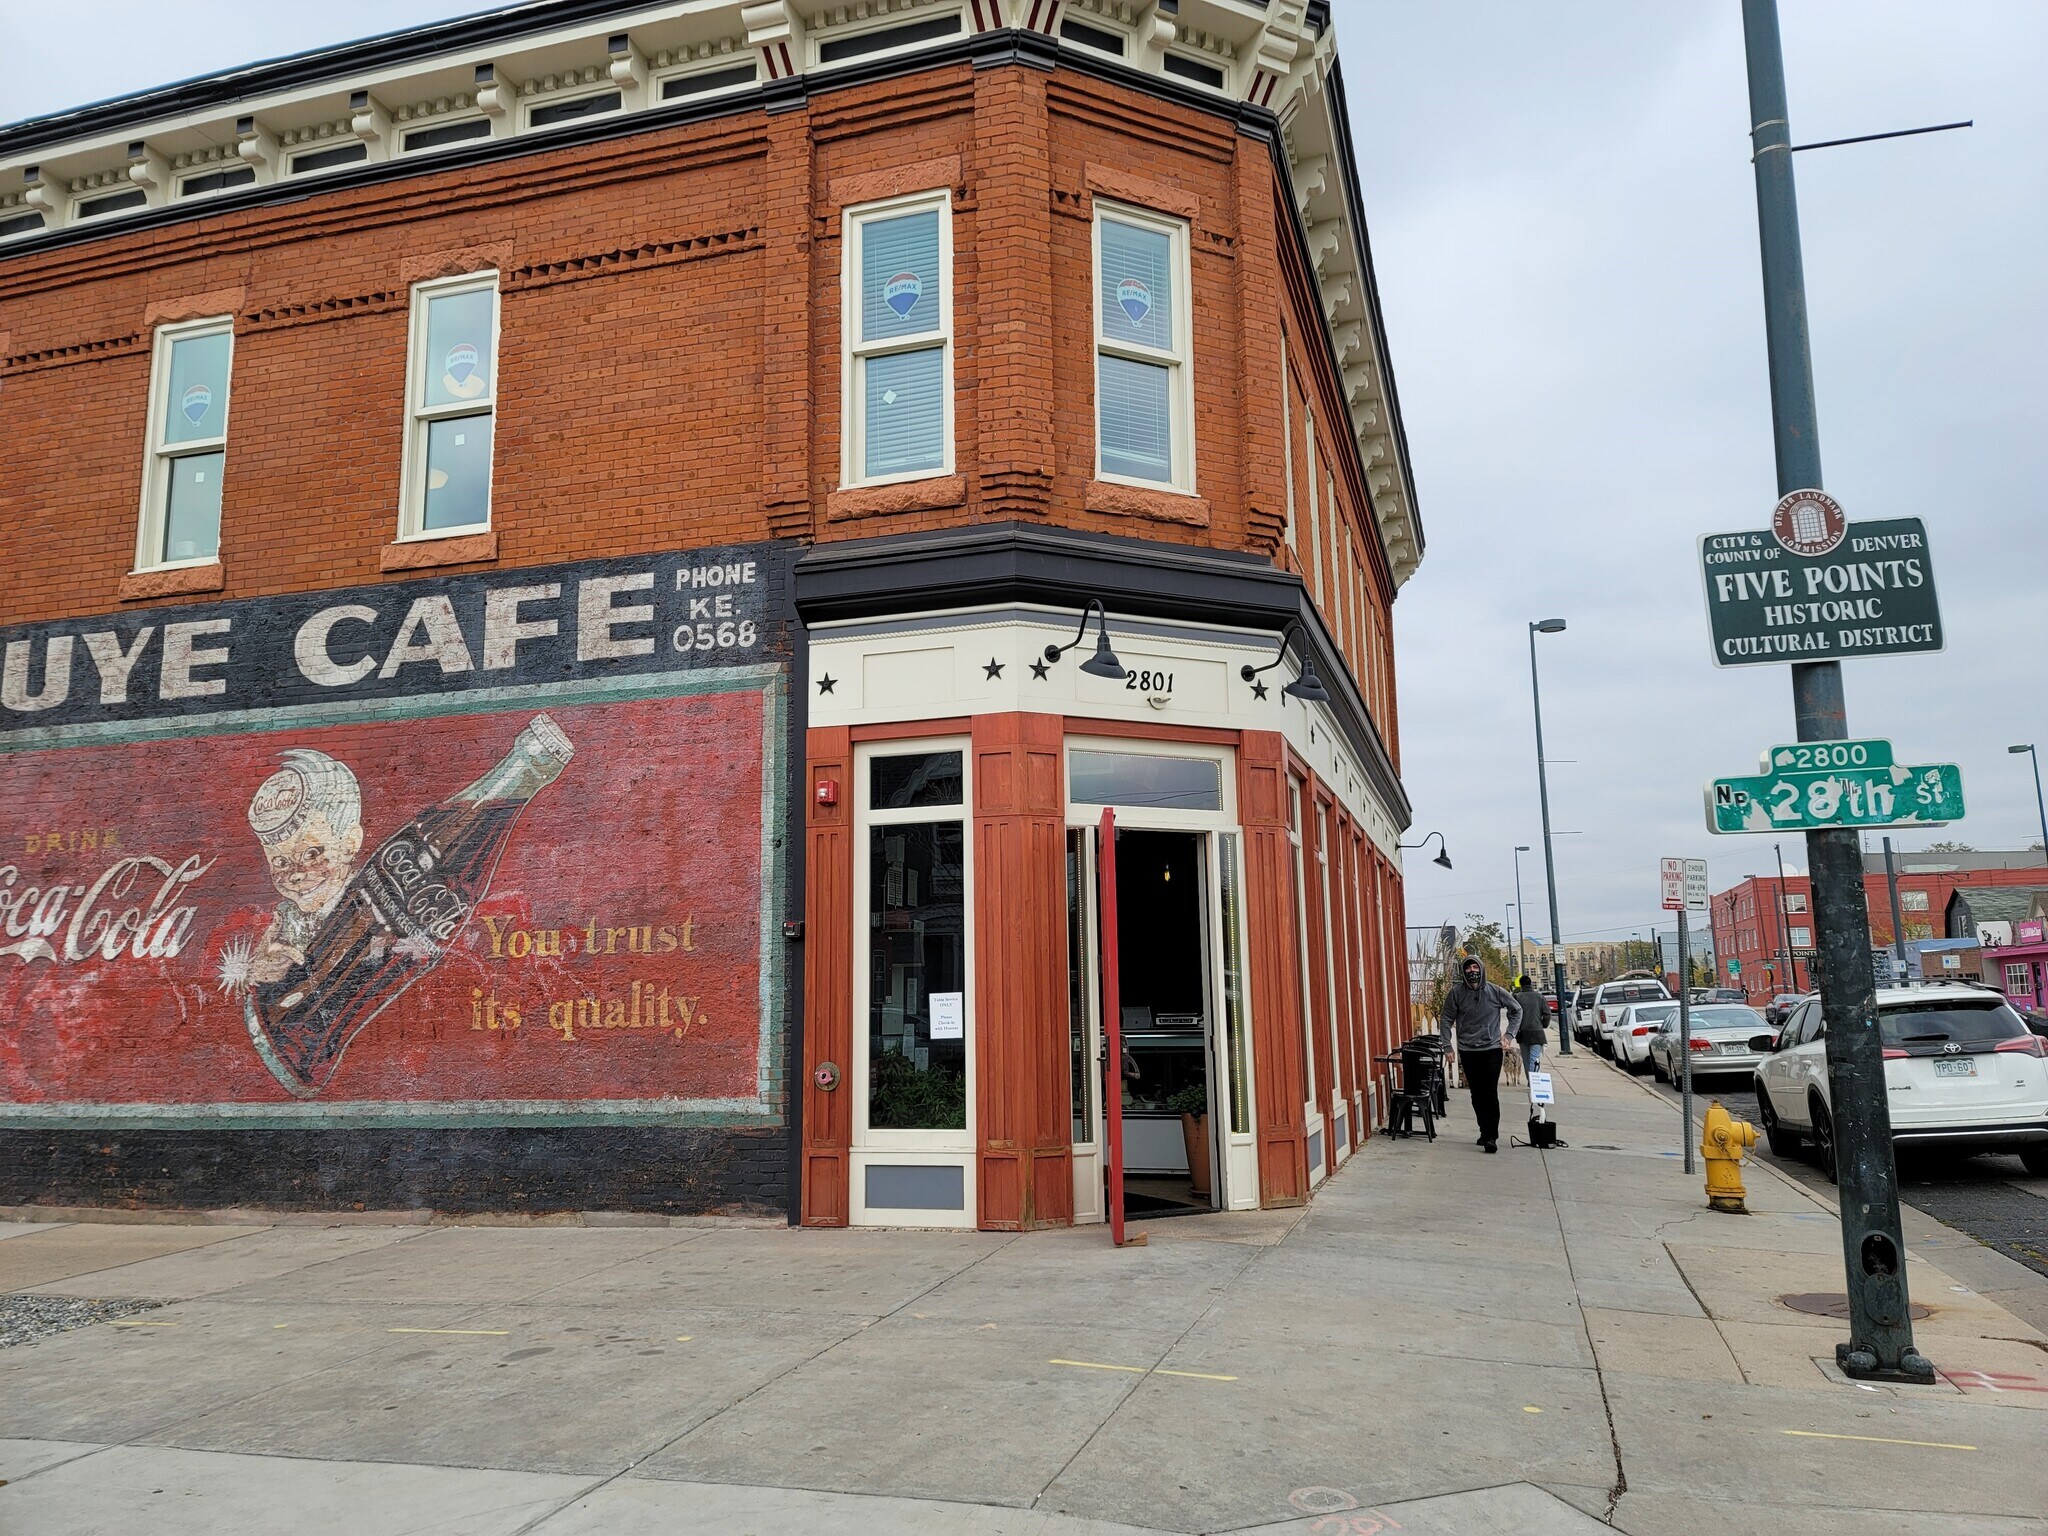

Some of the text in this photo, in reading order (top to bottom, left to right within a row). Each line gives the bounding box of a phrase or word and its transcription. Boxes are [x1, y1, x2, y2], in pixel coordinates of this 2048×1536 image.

[890, 284, 917, 294] RE/MAX
[1121, 290, 1146, 300] RE/MAX
[1774, 492, 1844, 527] DENVER LANDMARK
[1712, 534, 1762, 549] CITY &
[1781, 530, 1842, 553] COMMISSION
[1851, 533, 1923, 554] DENVER
[1705, 547, 1781, 565] COUNTY OF
[675, 562, 756, 591] PHONE
[1715, 558, 1924, 602] FIVE POINTS
[689, 594, 741, 620] KE.
[1764, 597, 1883, 627] HISTORIC
[1, 573, 655, 712] UYE CAFE
[672, 620, 757, 652] 0568
[1722, 623, 1933, 656] CULTURAL DISTRICT
[1125, 669, 1174, 693] 2801
[1796, 744, 1868, 768] 2800
[1769, 775, 1895, 821] 28th
[24, 826, 121, 853] DRINK
[1663, 871, 1683, 882] PARKING
[1667, 861, 1677, 871] NO
[1686, 874, 1706, 882] PARKING
[480, 912, 696, 958] You trust
[470, 979, 709, 1042] its quality.
